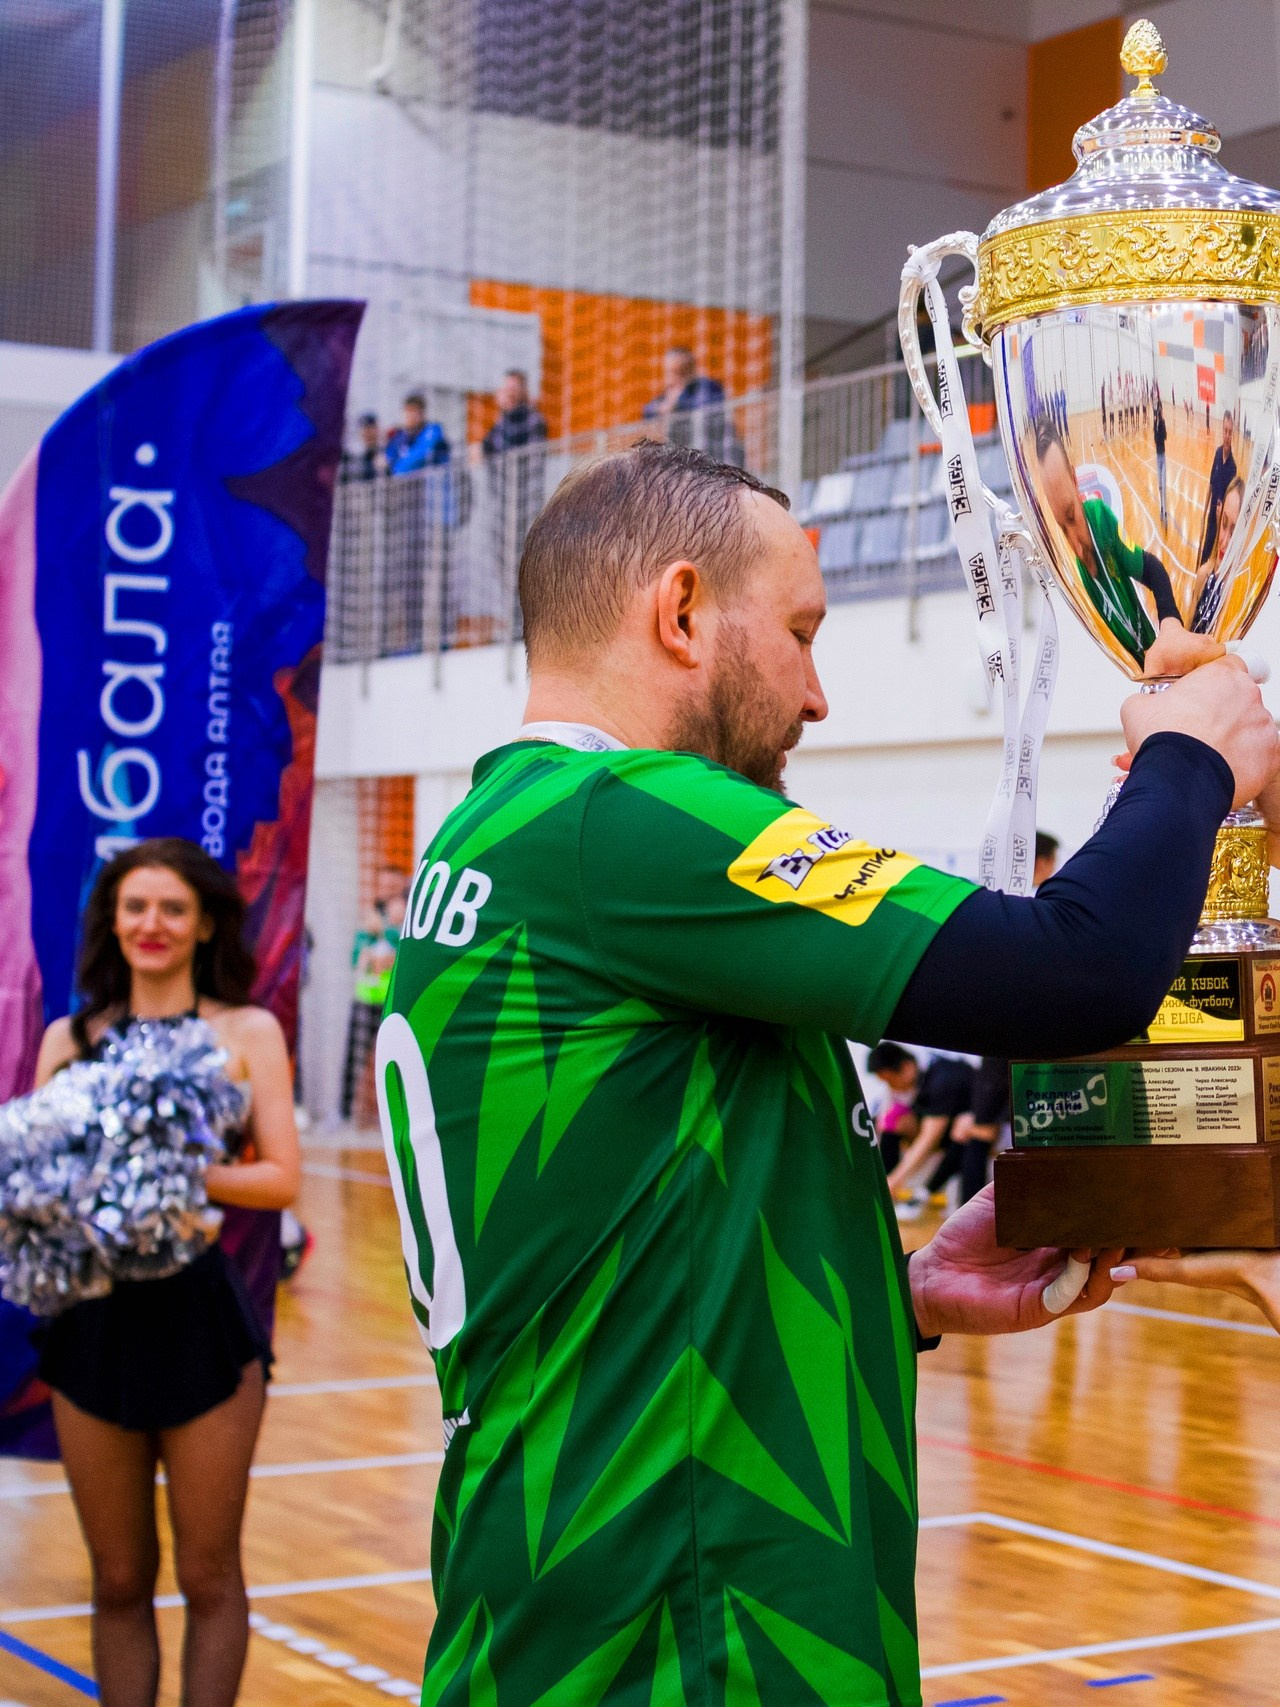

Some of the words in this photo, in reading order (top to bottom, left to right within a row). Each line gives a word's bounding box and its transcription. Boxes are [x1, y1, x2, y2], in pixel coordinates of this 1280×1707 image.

[948, 454, 972, 523] ELIGA
[969, 552, 995, 621] ELIGA
[206, 621, 234, 743] АЛТАЯ
[202, 752, 230, 859] ВОДА
[1191, 976, 1229, 991] КУБОК
[1171, 1012, 1204, 1025] ELIGA
